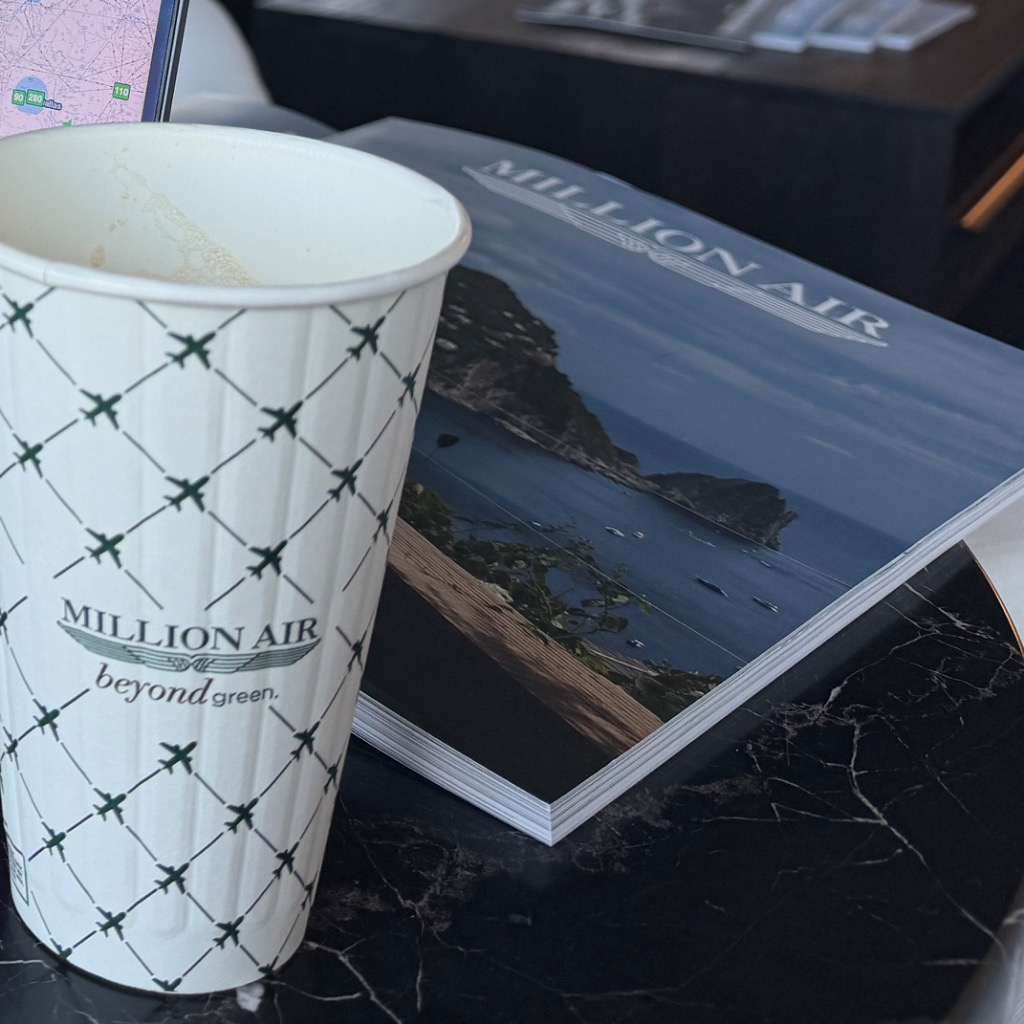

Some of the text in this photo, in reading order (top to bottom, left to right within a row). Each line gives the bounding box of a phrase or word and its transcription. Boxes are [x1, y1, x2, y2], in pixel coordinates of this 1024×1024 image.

[476, 158, 891, 340] MILLION AIR
[61, 597, 321, 651] MILLION AIR
[95, 661, 214, 705] beyond
